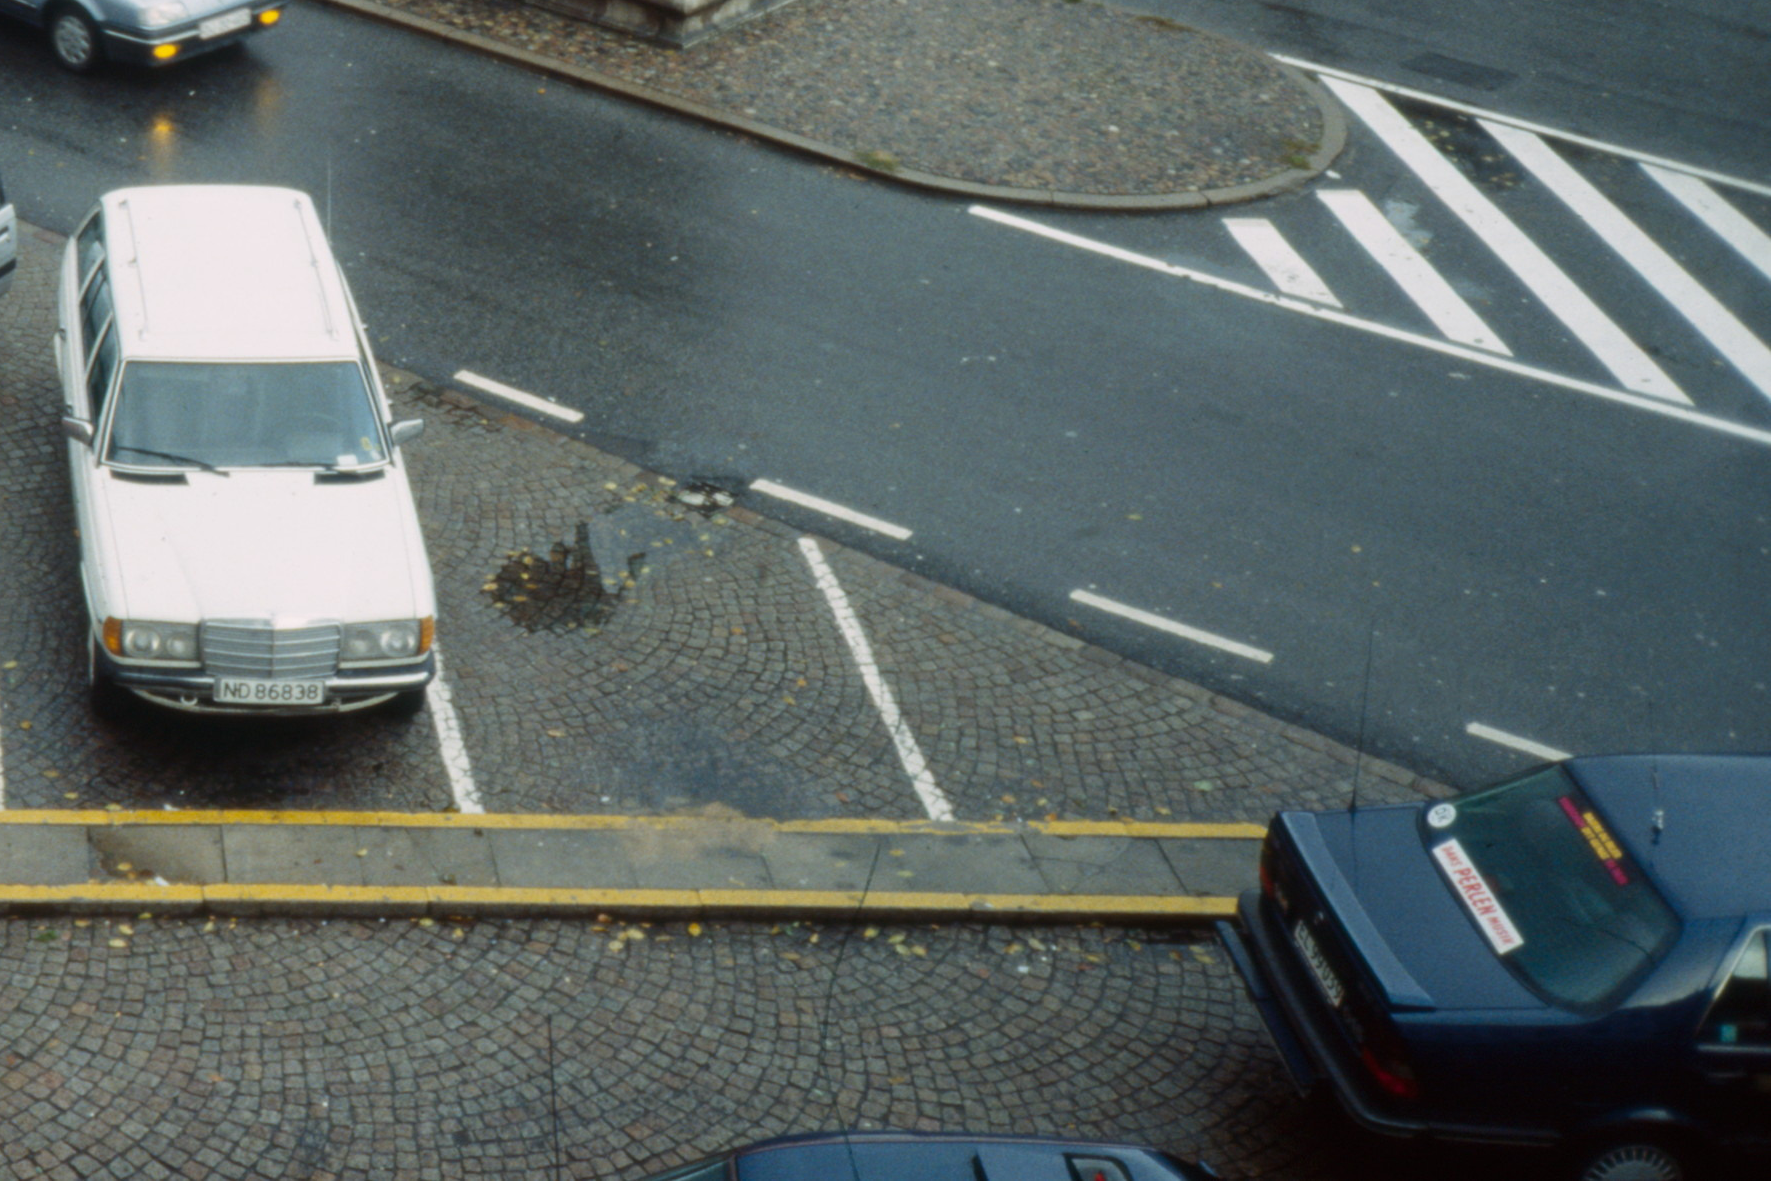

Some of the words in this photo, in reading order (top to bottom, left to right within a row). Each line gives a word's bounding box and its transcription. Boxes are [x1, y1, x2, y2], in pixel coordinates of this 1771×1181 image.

[223, 683, 250, 699] ND
[254, 684, 319, 700] 86838
[1454, 867, 1497, 916] PERLEN
